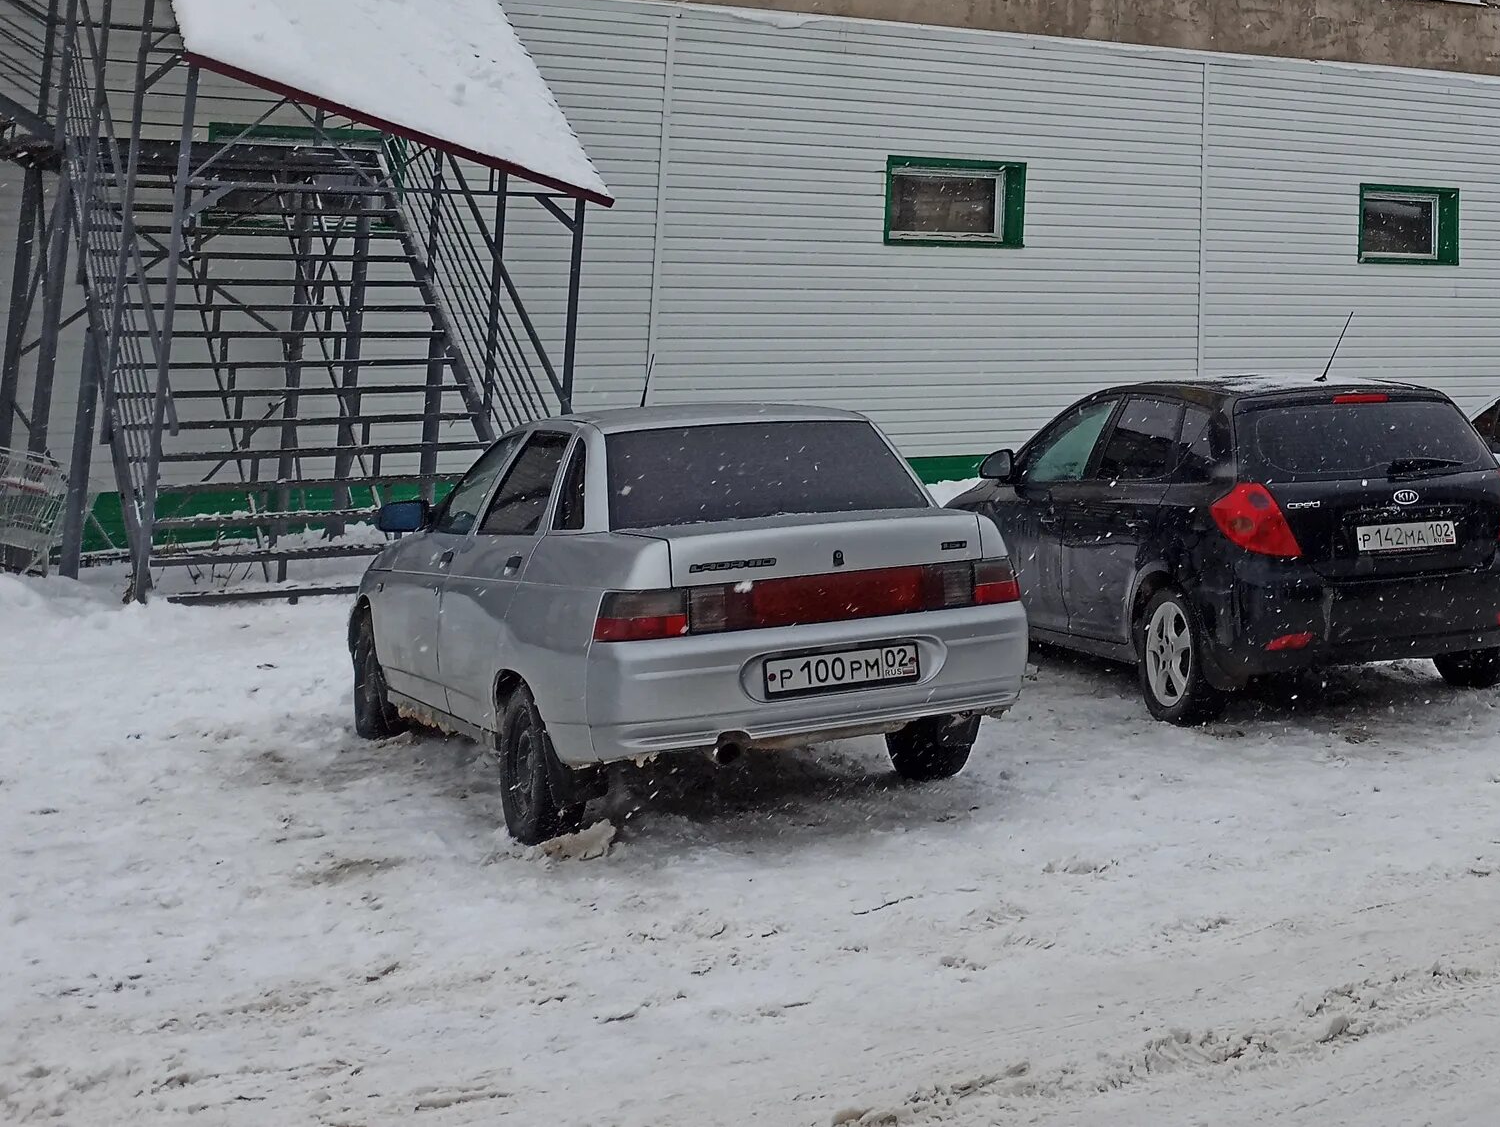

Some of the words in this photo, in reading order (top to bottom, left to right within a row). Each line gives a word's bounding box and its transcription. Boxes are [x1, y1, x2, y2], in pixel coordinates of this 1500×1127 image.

[1397, 491, 1417, 502] KIA
[884, 648, 908, 668] 02
[885, 668, 903, 676] RUS
